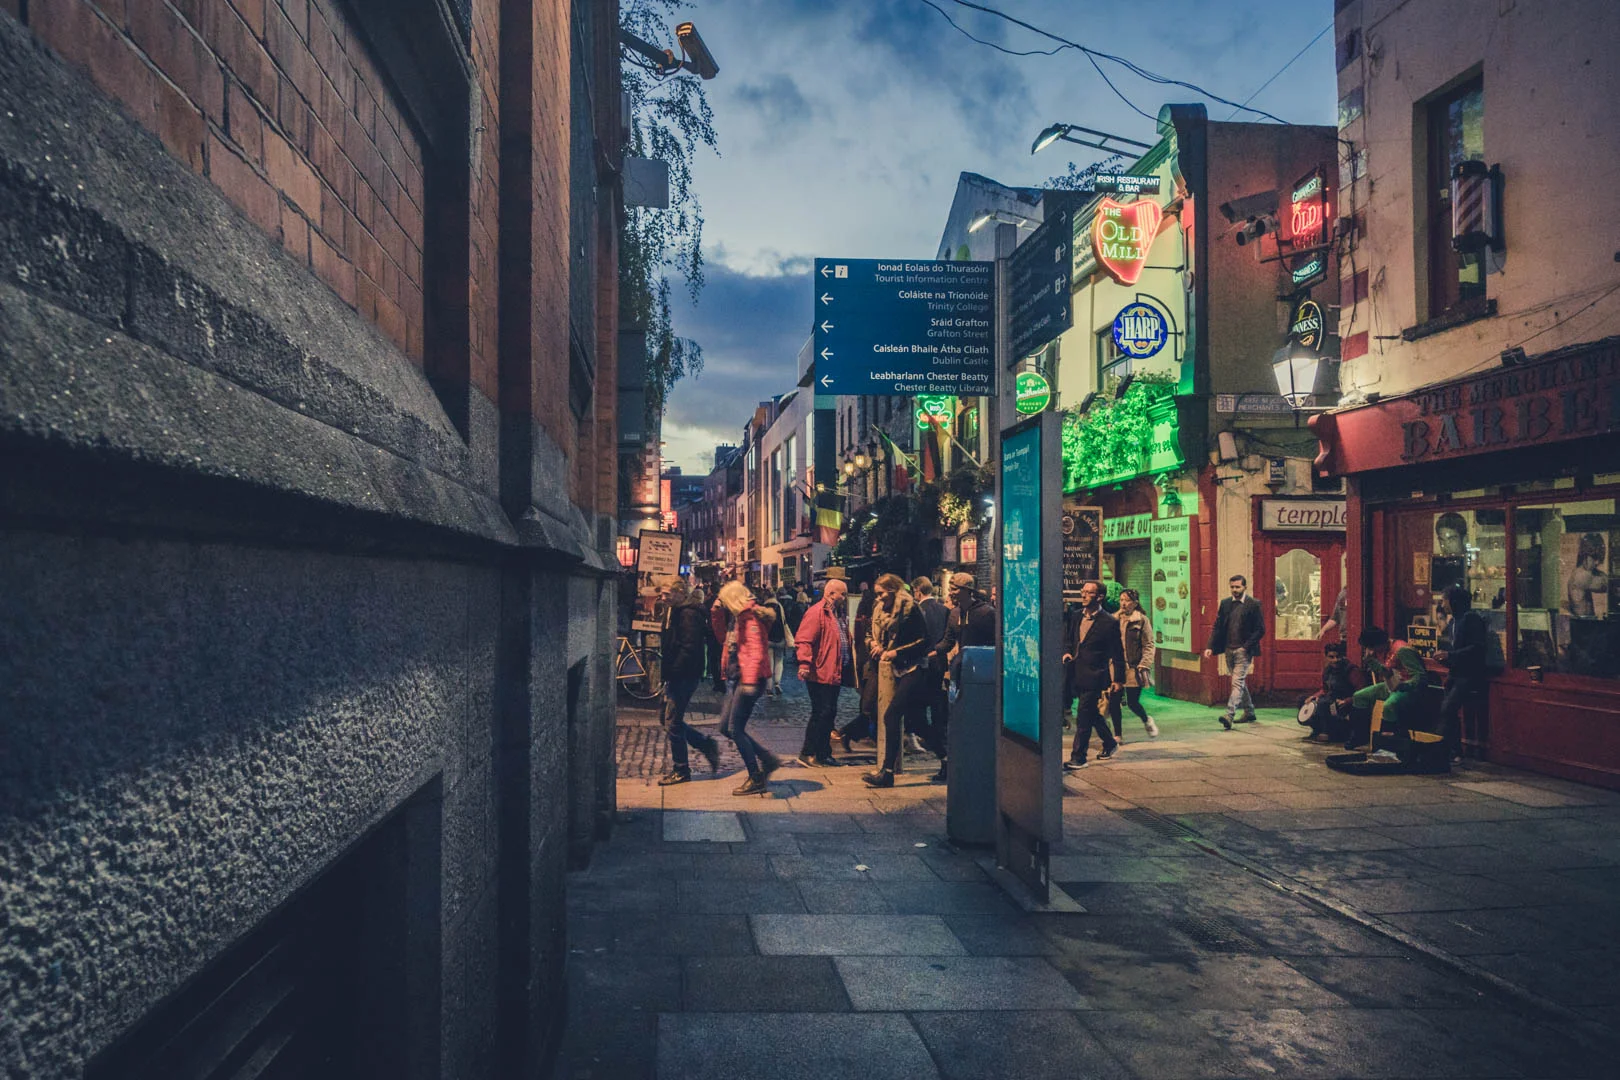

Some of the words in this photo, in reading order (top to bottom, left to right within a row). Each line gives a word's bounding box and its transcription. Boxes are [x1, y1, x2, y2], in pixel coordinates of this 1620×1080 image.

[1096, 176, 1115, 184] IRISH
[1117, 176, 1160, 186] RESTAURANT
[1118, 184, 1124, 192] &
[1125, 185, 1140, 193] BAR
[1103, 207, 1122, 217] THE
[1292, 205, 1317, 235] OLD
[1100, 220, 1143, 241] OLD
[1102, 243, 1145, 260] MILL
[878, 263, 903, 272] Ionad
[905, 264, 930, 272] Eolais
[932, 264, 944, 272] do
[875, 274, 904, 283] Tourist
[906, 275, 958, 284] Information
[960, 276, 989, 285] Centre
[898, 291, 933, 299] Coláiste
[935, 292, 946, 300] na
[928, 302, 954, 312] Trinity
[956, 302, 989, 312] College
[931, 318, 953, 327] Sráid
[955, 319, 989, 327] Grafton
[1124, 316, 1160, 340] HARP
[927, 329, 961, 338] Grafton
[963, 330, 989, 338] Street
[873, 344, 909, 353] Caisleán
[911, 345, 938, 353] Bhaile
[940, 344, 961, 354] Átha
[963, 345, 989, 354] Cliath
[932, 356, 961, 365] Dublin
[963, 356, 989, 365] Castle
[870, 372, 925, 380] Leabharlann
[926, 372, 959, 381] Chester
[961, 373, 989, 383] Beatty
[894, 383, 927, 392] Chester
[929, 384, 957, 393] Beatty
[959, 384, 989, 393] Library
[1411, 385, 1463, 416] THE
[1117, 520, 1135, 537] TAKE
[1153, 523, 1170, 534] TEMPLE
